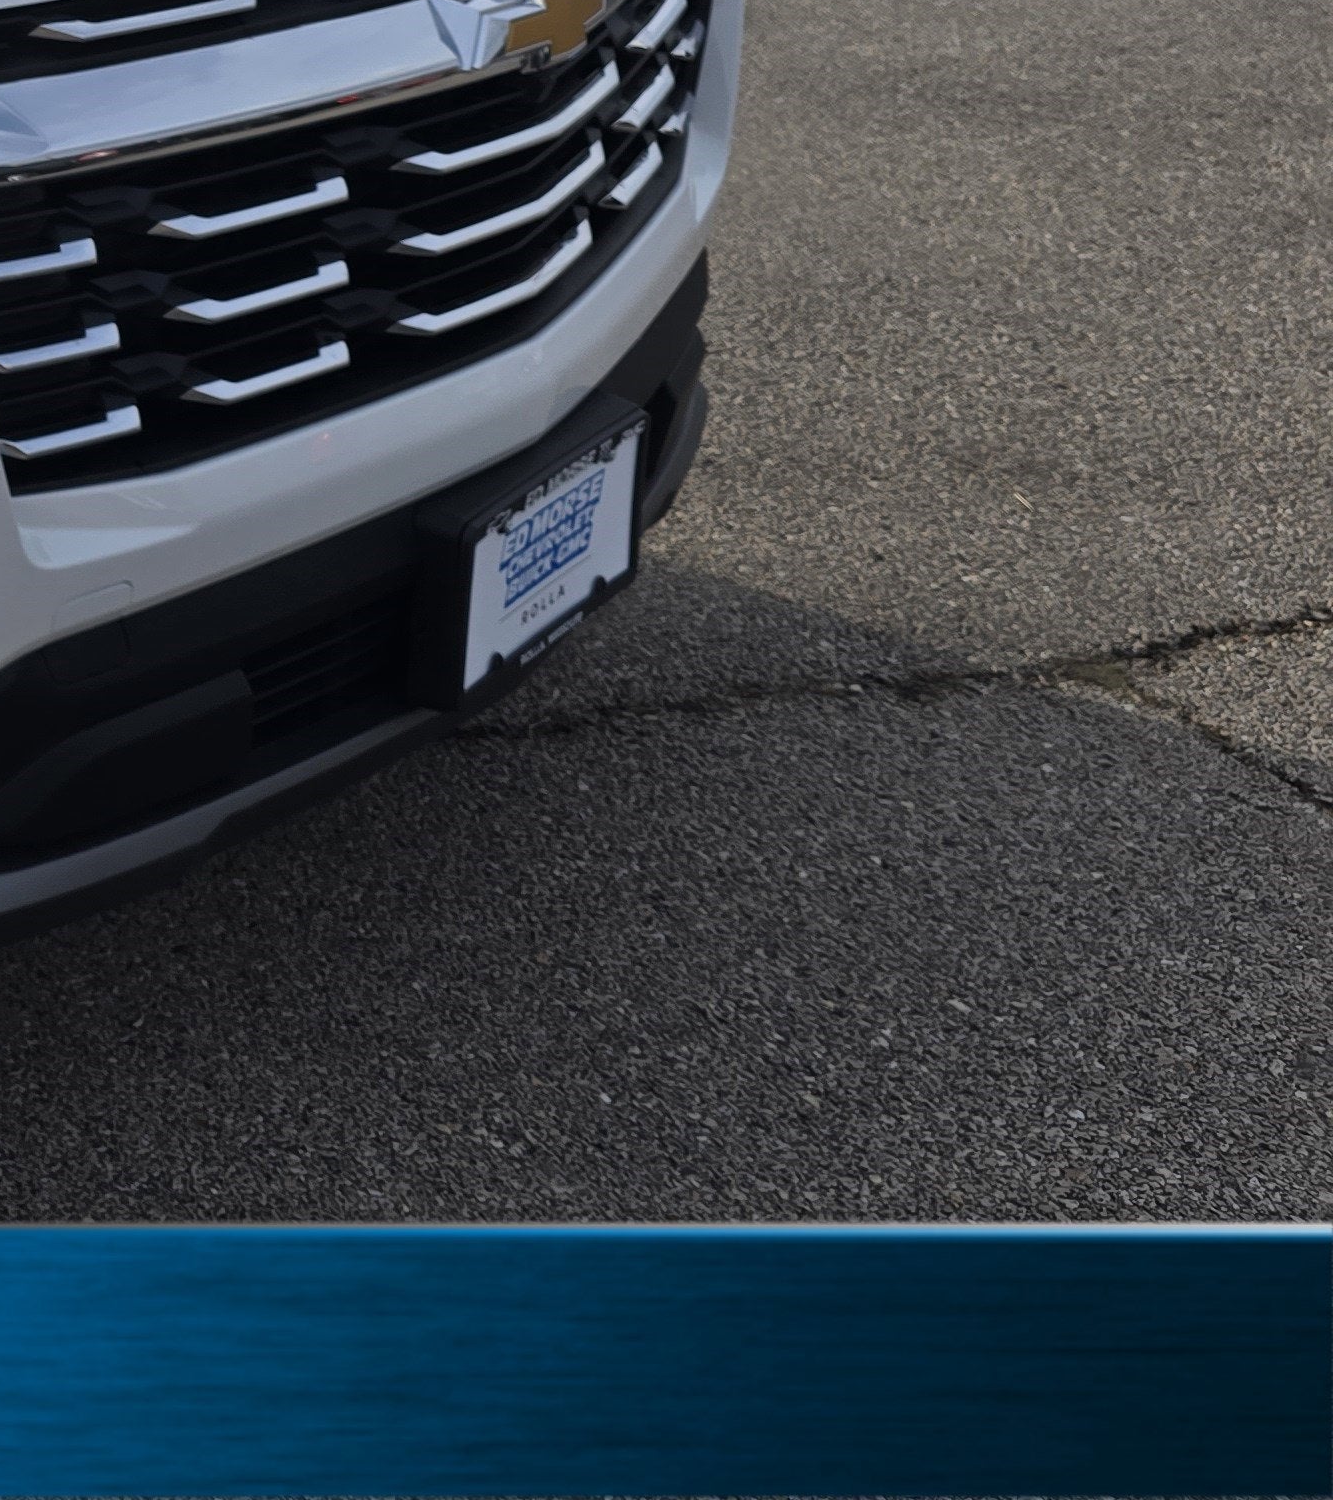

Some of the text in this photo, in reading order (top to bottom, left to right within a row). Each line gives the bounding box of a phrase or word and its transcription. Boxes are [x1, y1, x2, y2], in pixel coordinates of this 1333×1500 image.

[503, 472, 604, 554] ED MORSE
[520, 585, 565, 625] ROLLA
